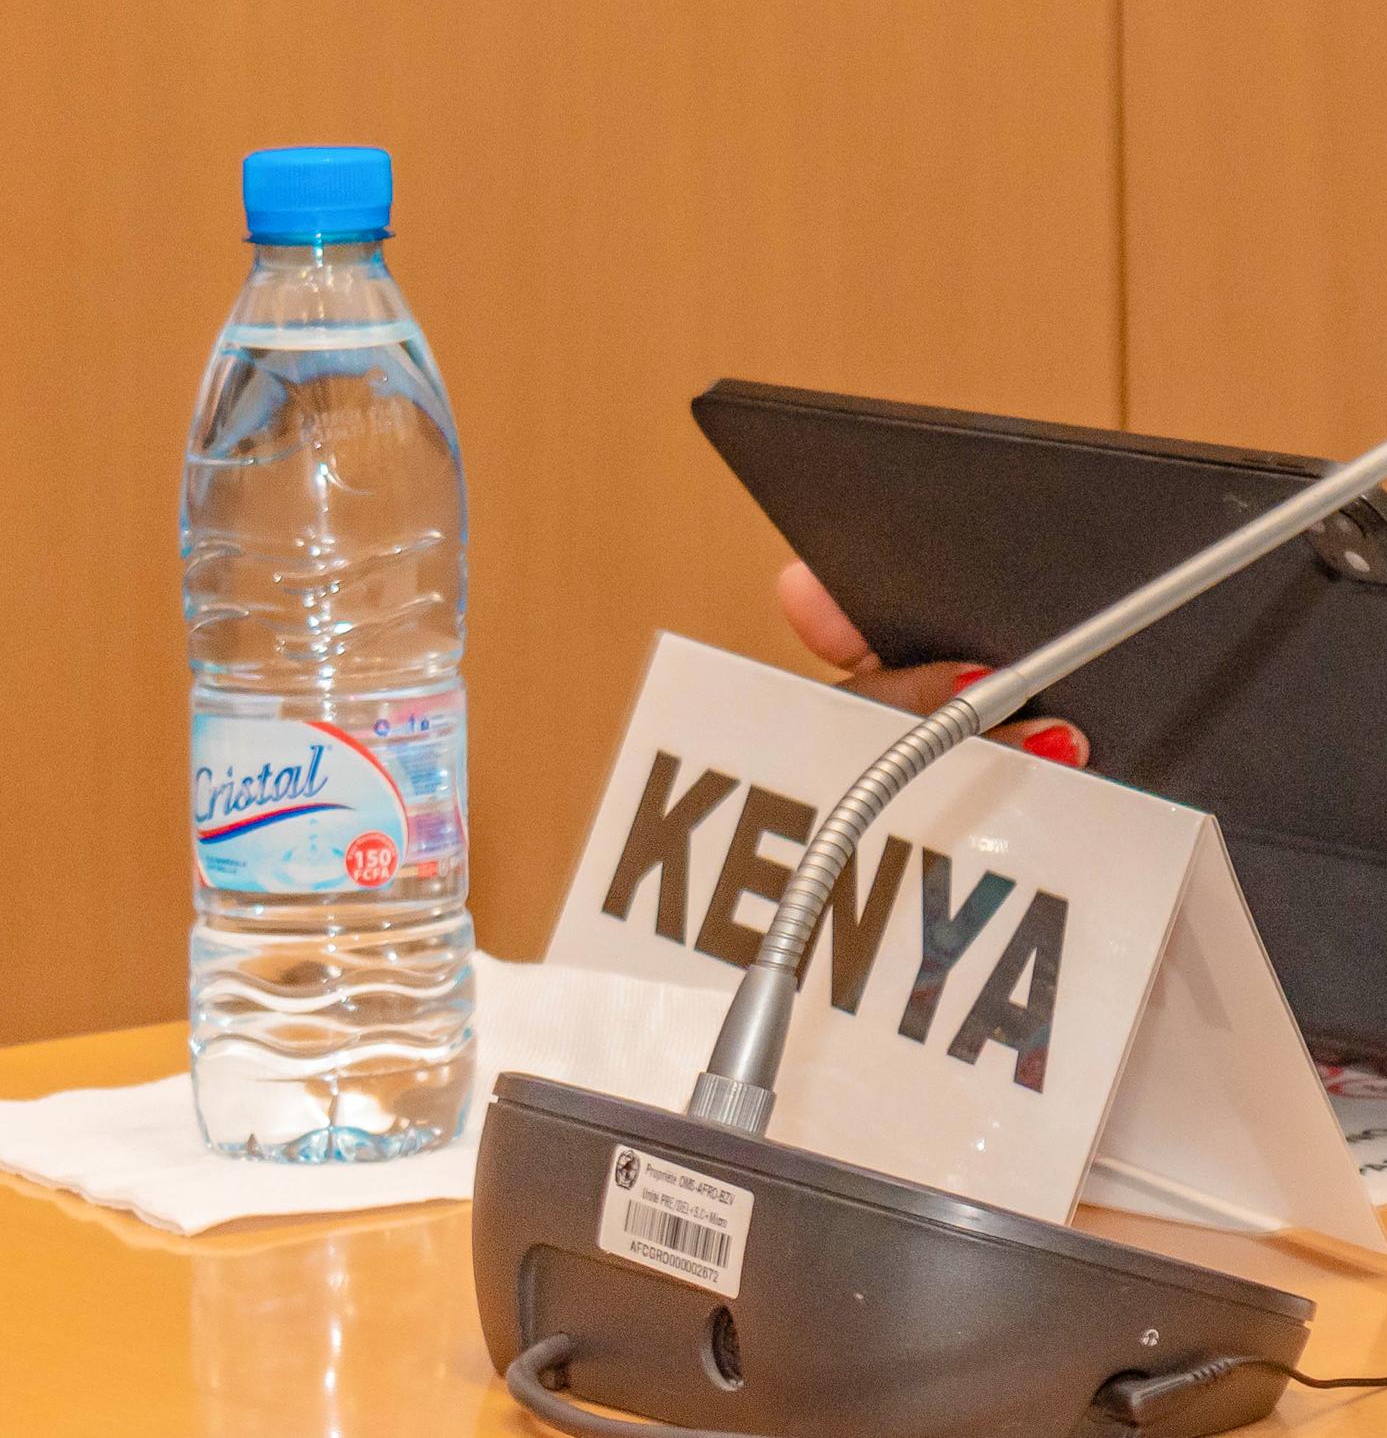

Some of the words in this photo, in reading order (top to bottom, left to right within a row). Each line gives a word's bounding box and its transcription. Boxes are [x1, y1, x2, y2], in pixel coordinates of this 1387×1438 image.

[195, 744, 329, 823] Cristal
[354, 848, 393, 870] 150
[602, 749, 1070, 1095] KENYA
